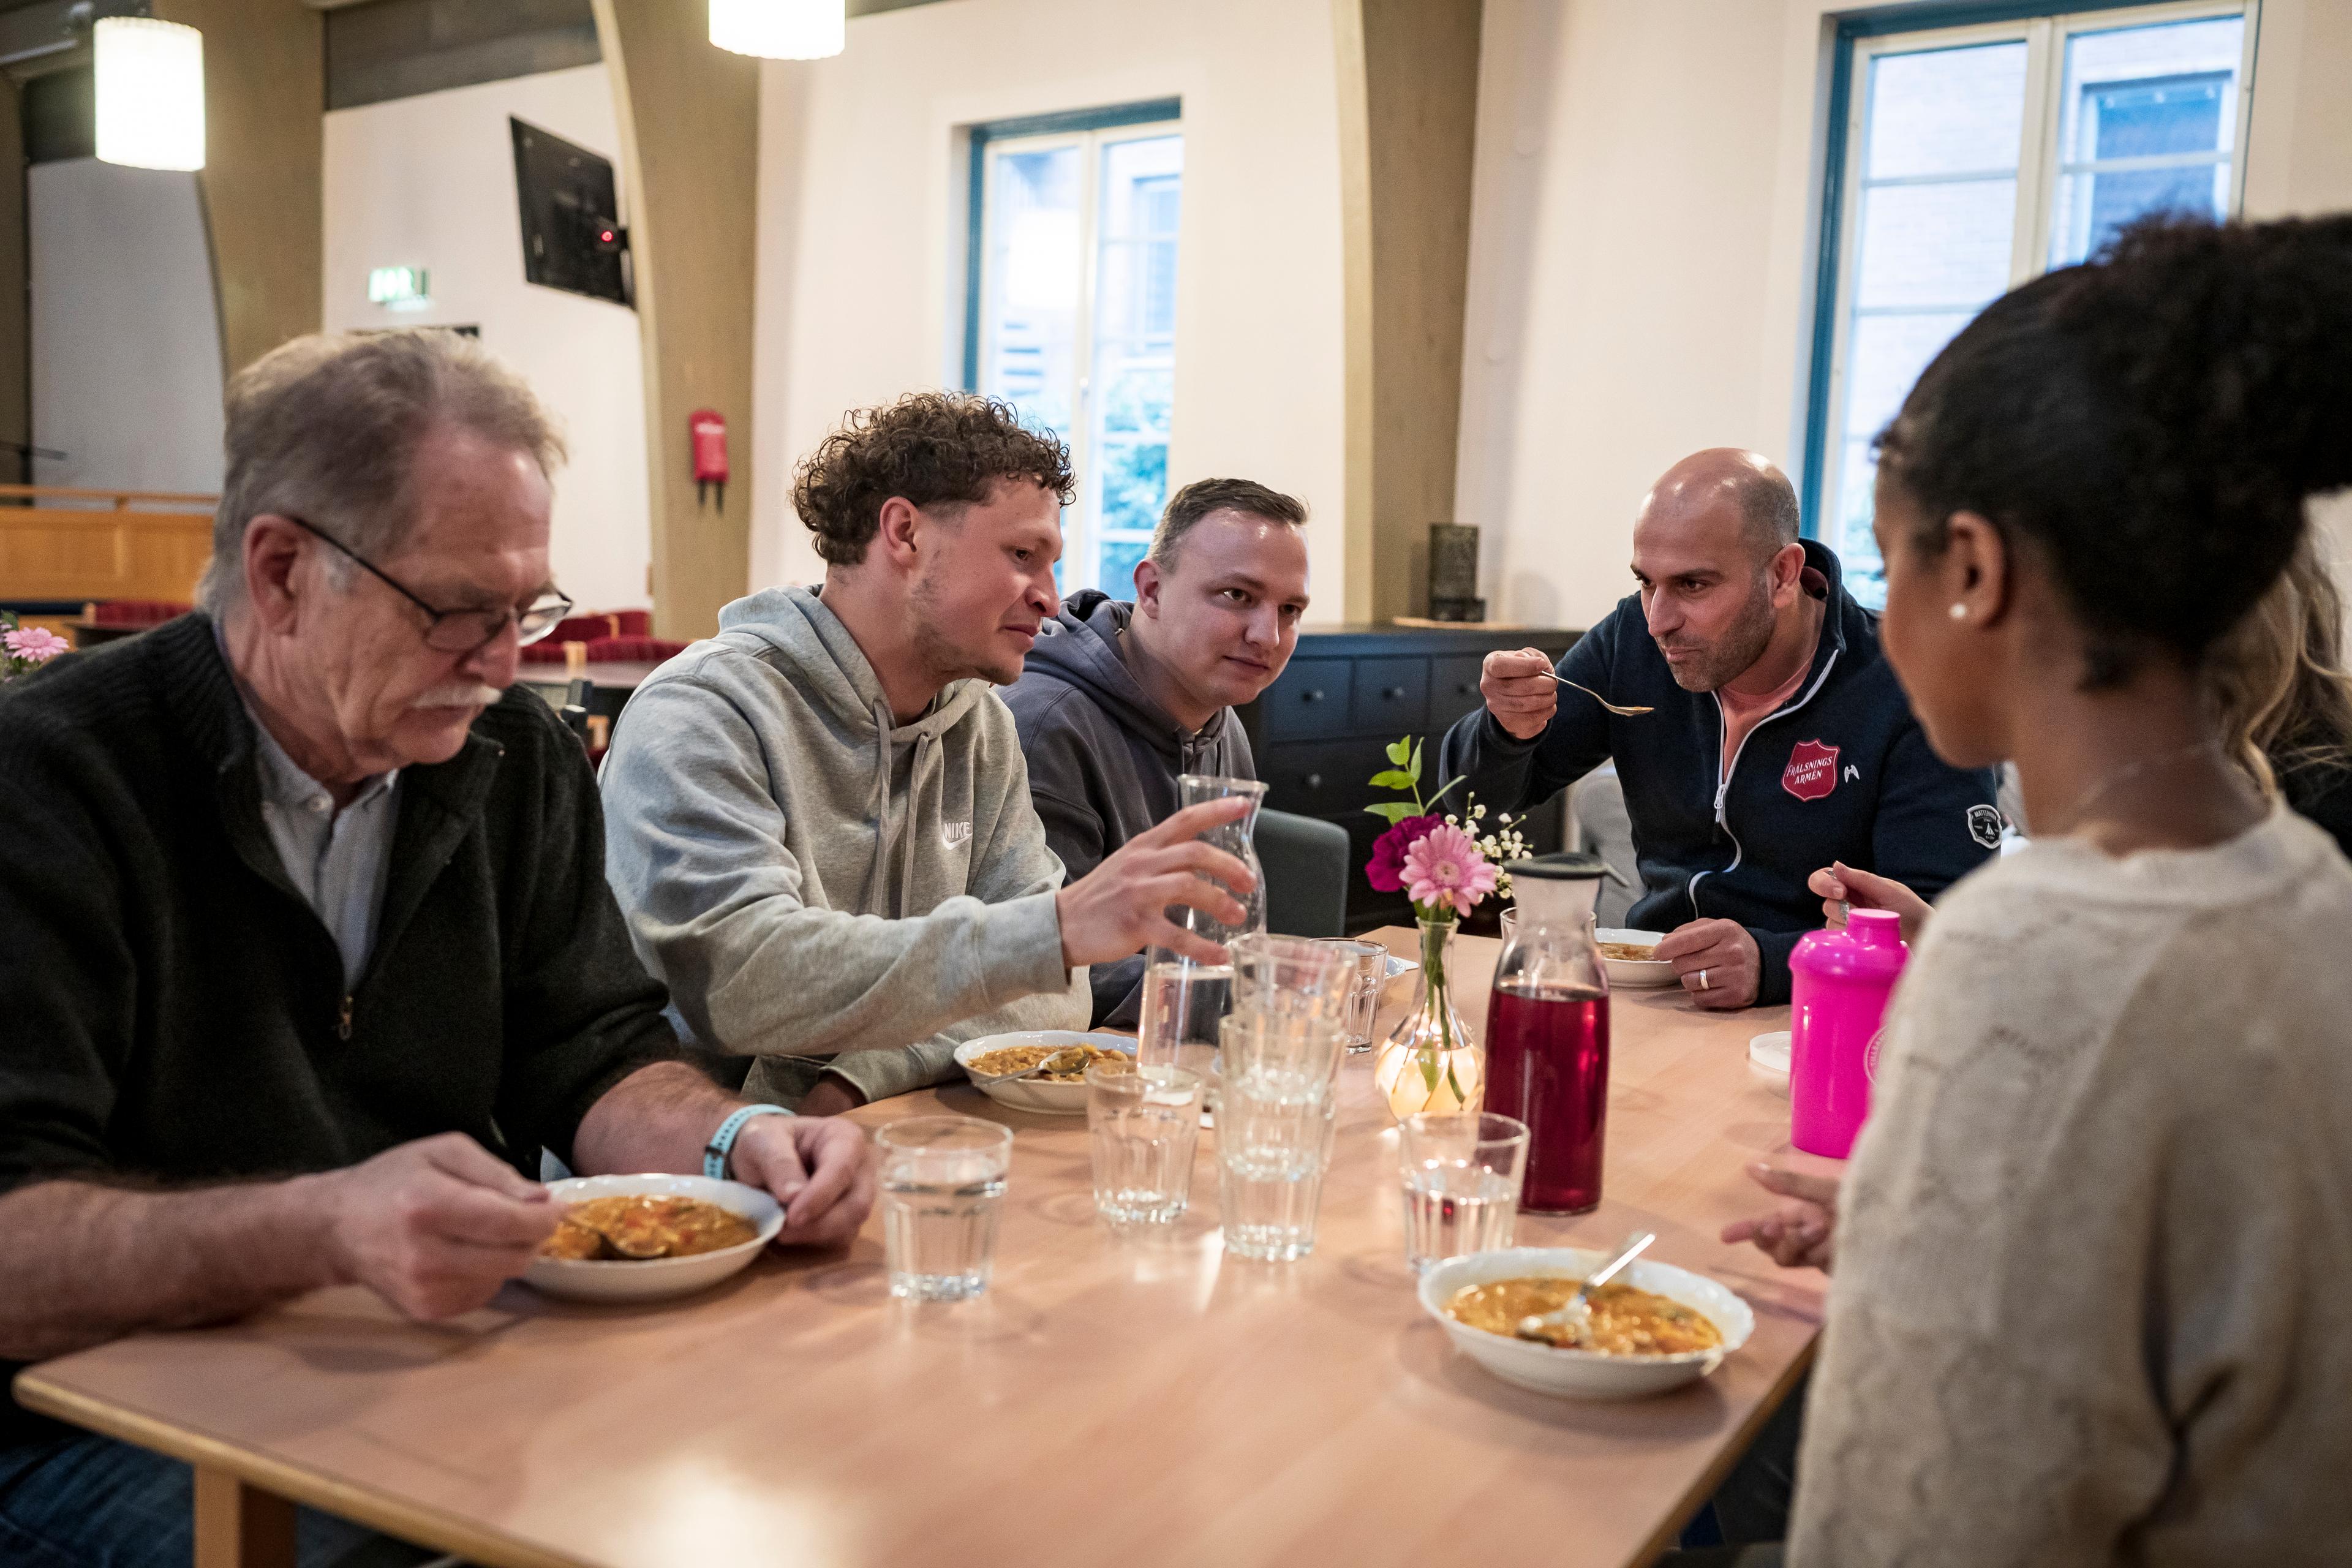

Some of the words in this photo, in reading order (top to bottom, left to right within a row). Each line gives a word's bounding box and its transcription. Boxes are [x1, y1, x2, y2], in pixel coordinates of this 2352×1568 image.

[1786, 756, 1833, 777] FRÄLSNINGS
[1794, 769, 1823, 785] ARMÉN
[944, 821, 971, 839] NIKE
